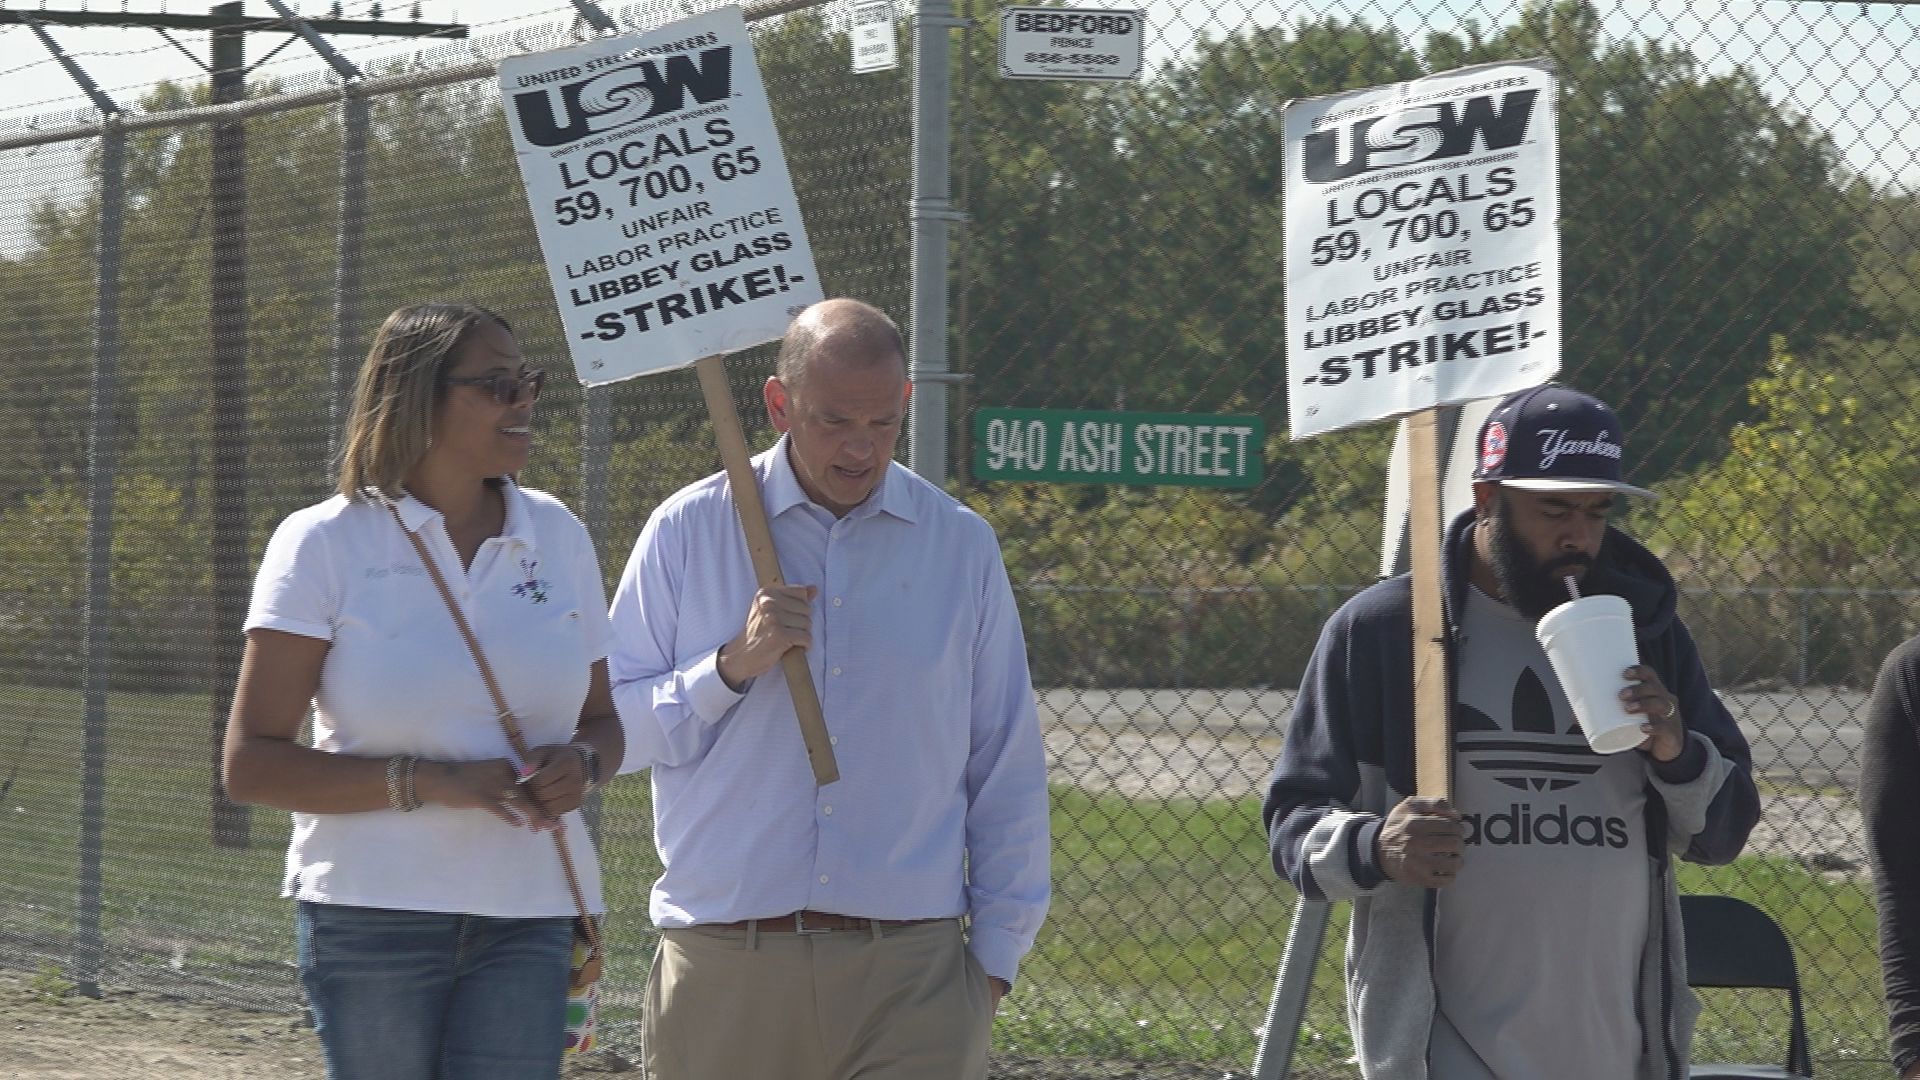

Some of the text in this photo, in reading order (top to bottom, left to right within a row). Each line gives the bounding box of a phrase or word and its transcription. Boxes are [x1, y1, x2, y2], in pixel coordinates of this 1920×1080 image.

[1016, 13, 1133, 35] BEDFORD
[1050, 37, 1095, 49] FENCE
[516, 31, 719, 88] UNITED STEELWORKERS
[1024, 52, 1121, 66] 856-5500
[513, 46, 733, 147] USW
[1312, 76, 1529, 127] UNITED EELWORKERS
[550, 103, 730, 158] UNITY AND STRENGTH FOR WORKERS
[559, 118, 735, 190] LOCALS
[1302, 89, 1541, 184] USW
[555, 146, 761, 226] 59, 700, 65
[1322, 151, 1519, 195] UNITY AND STRENGTH FOR WORKERS
[1326, 168, 1517, 229] LOCALS
[565, 207, 783, 280] LABOR PRACTICE
[622, 201, 713, 239] UNFAIR
[1310, 197, 1537, 267] 59, 700, 65
[570, 232, 793, 307] LIBBEY GLASS
[1306, 261, 1542, 323] LABOR PRACTICE
[1373, 249, 1472, 282] UNFAIR
[580, 265, 804, 341] -STRIKE!-
[1303, 287, 1546, 350] LIBBEY GLASS
[1302, 321, 1548, 387] -STRIKE!-
[986, 418, 1254, 477] 940 ASH STREET
[1536, 428, 1623, 471] Yankees
[1460, 803, 1629, 849] adidas
